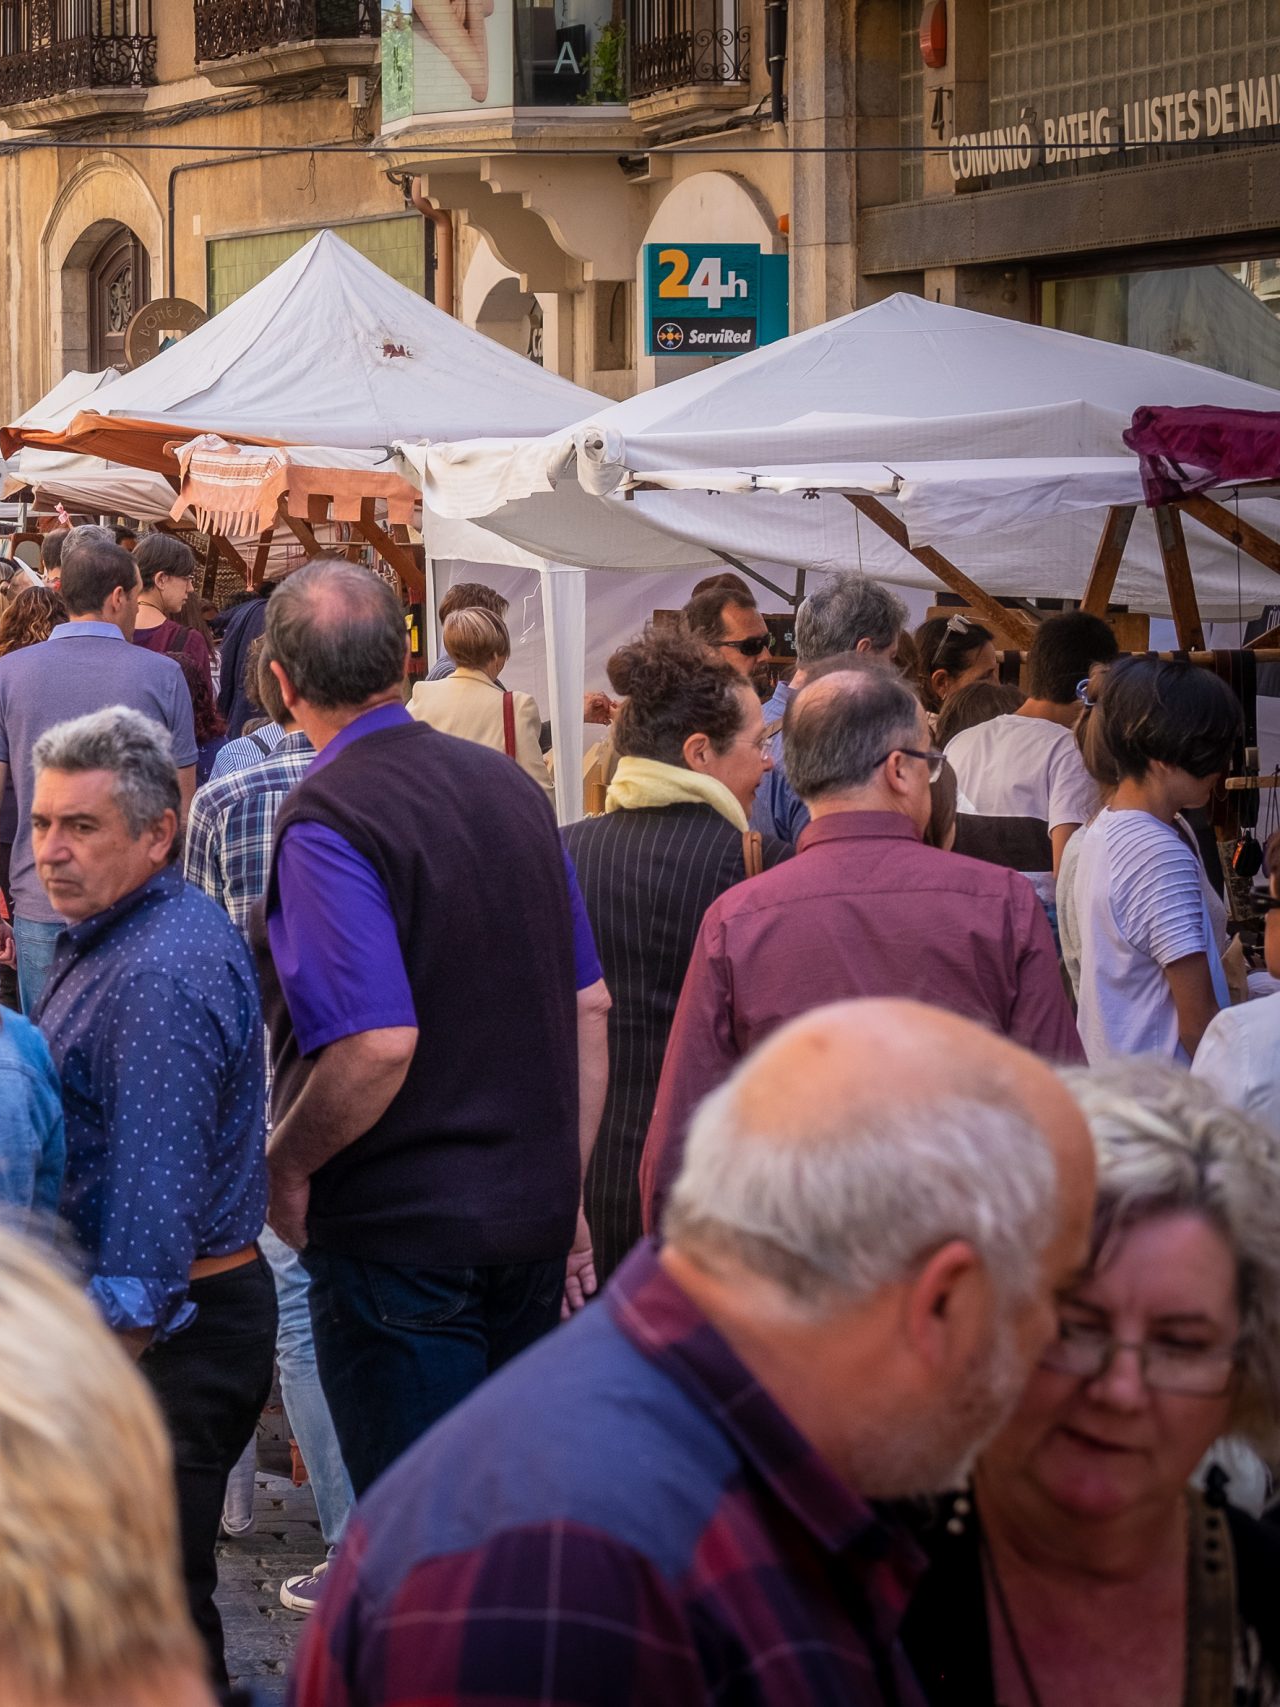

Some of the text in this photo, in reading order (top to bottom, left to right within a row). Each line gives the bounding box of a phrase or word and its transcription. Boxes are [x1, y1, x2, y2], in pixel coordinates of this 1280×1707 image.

[948, 73, 1280, 180] COMUNIÓ BATEIG LLISTES DE NAI
[658, 249, 748, 309] 24h
[688, 329, 751, 344] ServiRed
